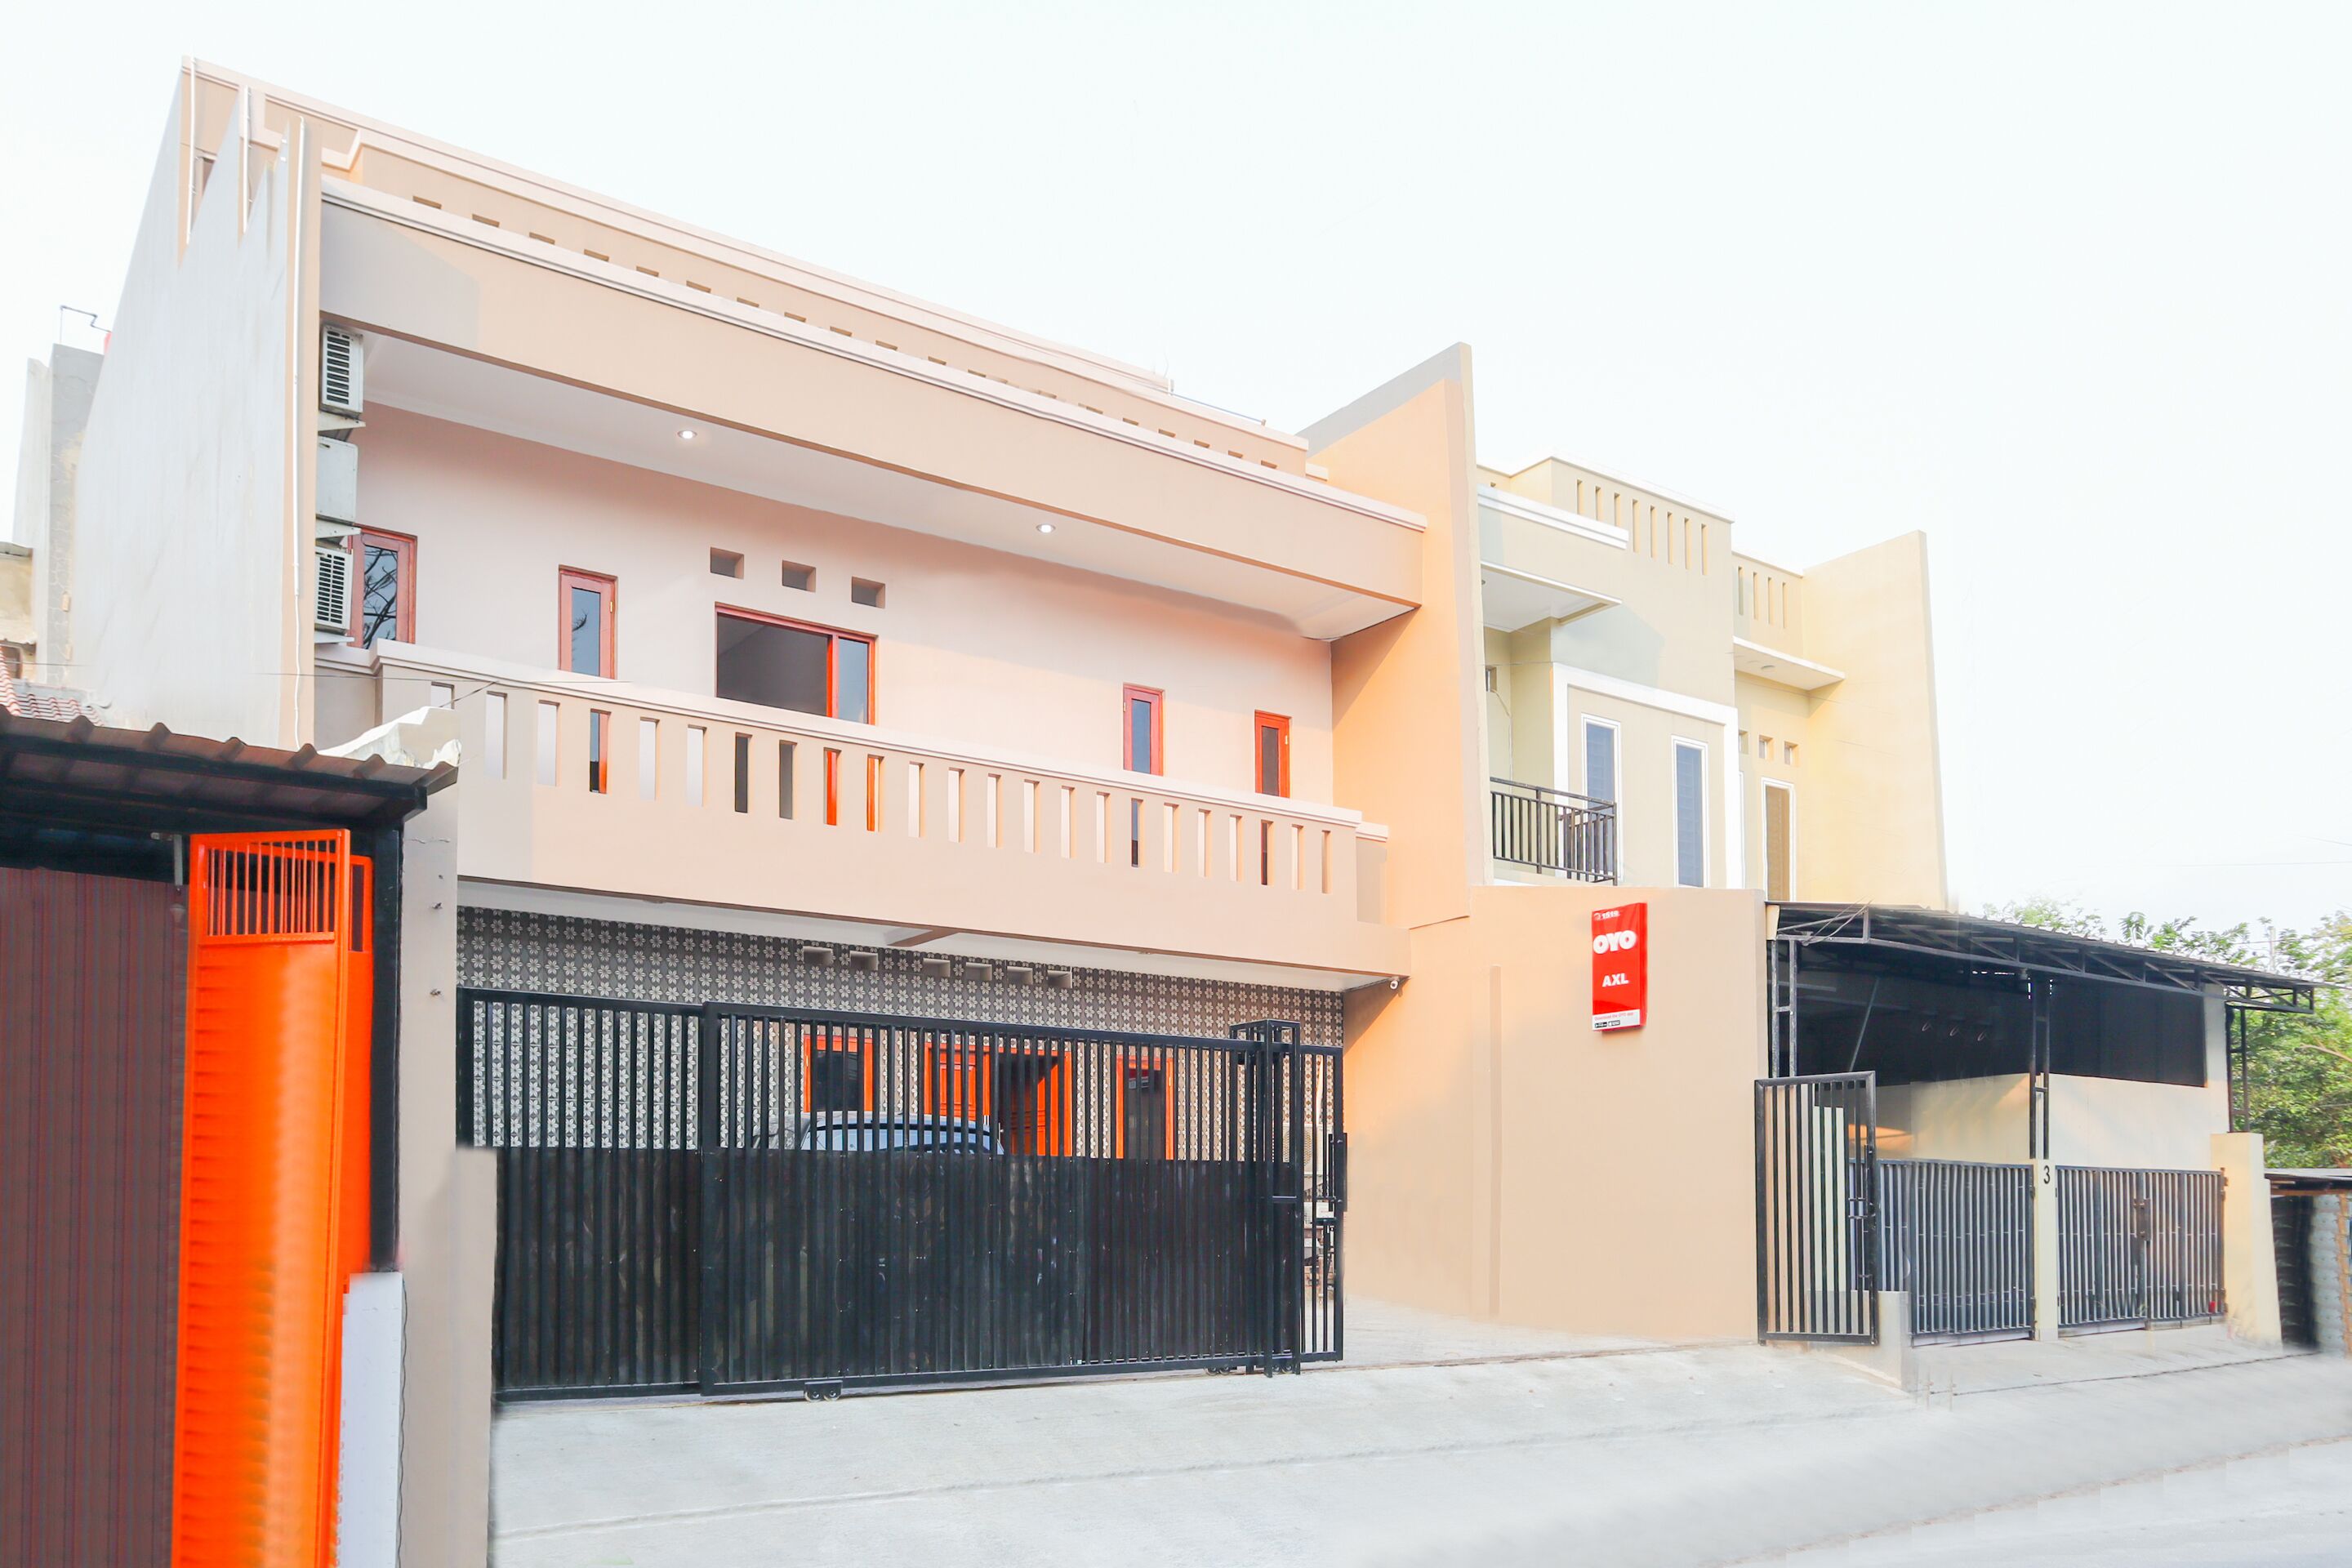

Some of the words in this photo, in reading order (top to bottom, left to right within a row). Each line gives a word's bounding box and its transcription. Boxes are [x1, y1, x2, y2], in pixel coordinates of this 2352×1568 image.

[1593, 930, 1636, 954] OYO
[1601, 973, 1629, 987] AXL
[2043, 1165, 2050, 1184] 3
